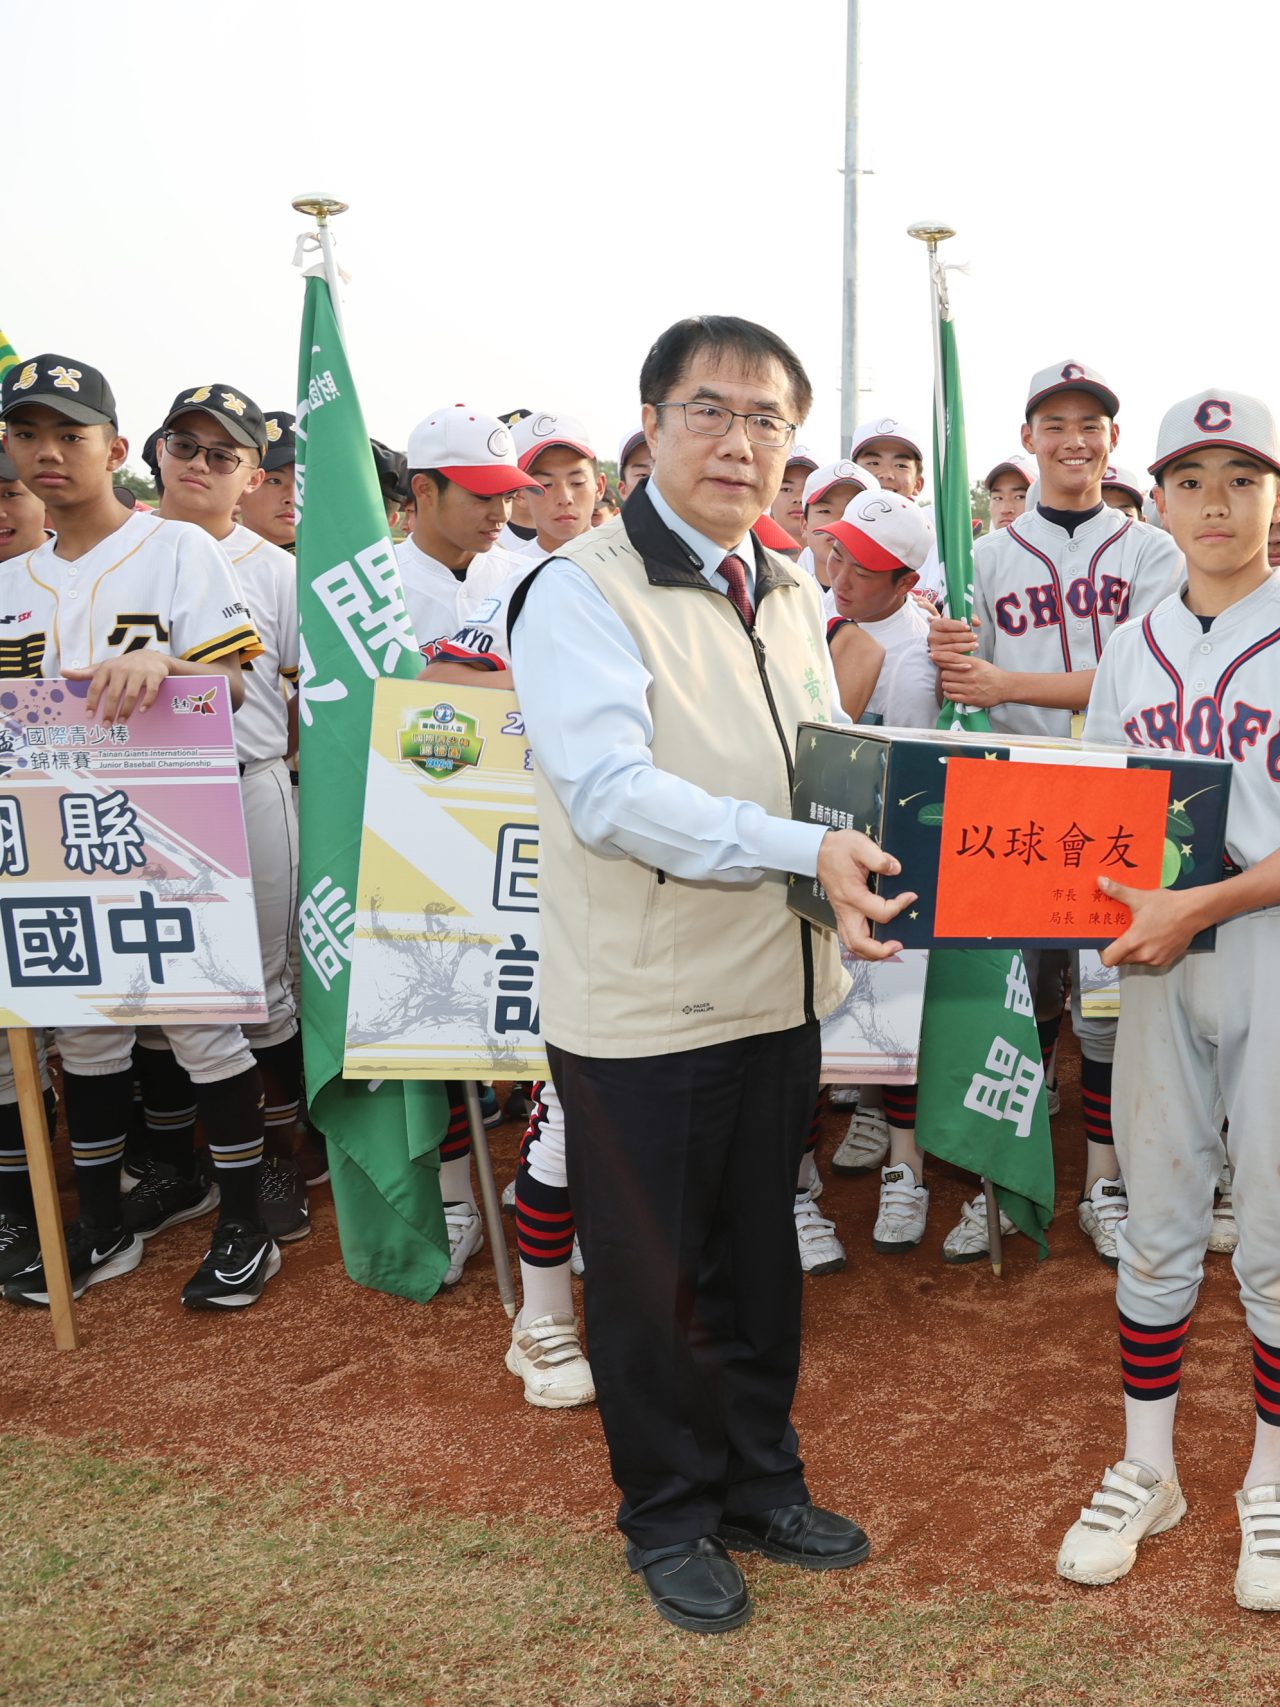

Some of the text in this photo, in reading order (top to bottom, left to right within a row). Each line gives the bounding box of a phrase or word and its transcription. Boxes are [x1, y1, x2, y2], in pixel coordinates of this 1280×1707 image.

[532, 415, 557, 437] C
[1193, 399, 1232, 434] C
[487, 427, 510, 458] C
[858, 500, 892, 522] C
[26, 725, 129, 747] 國際青少棒
[30, 751, 92, 771] 錦標賽
[150, 749, 198, 757] International
[123, 761, 156, 769] Baseball
[157, 760, 212, 769] Championship
[956, 820, 1138, 868] 以球會友
[1052, 888, 1077, 902] 市長
[1050, 911, 1075, 925] 局長
[0, 891, 195, 987] 國中
